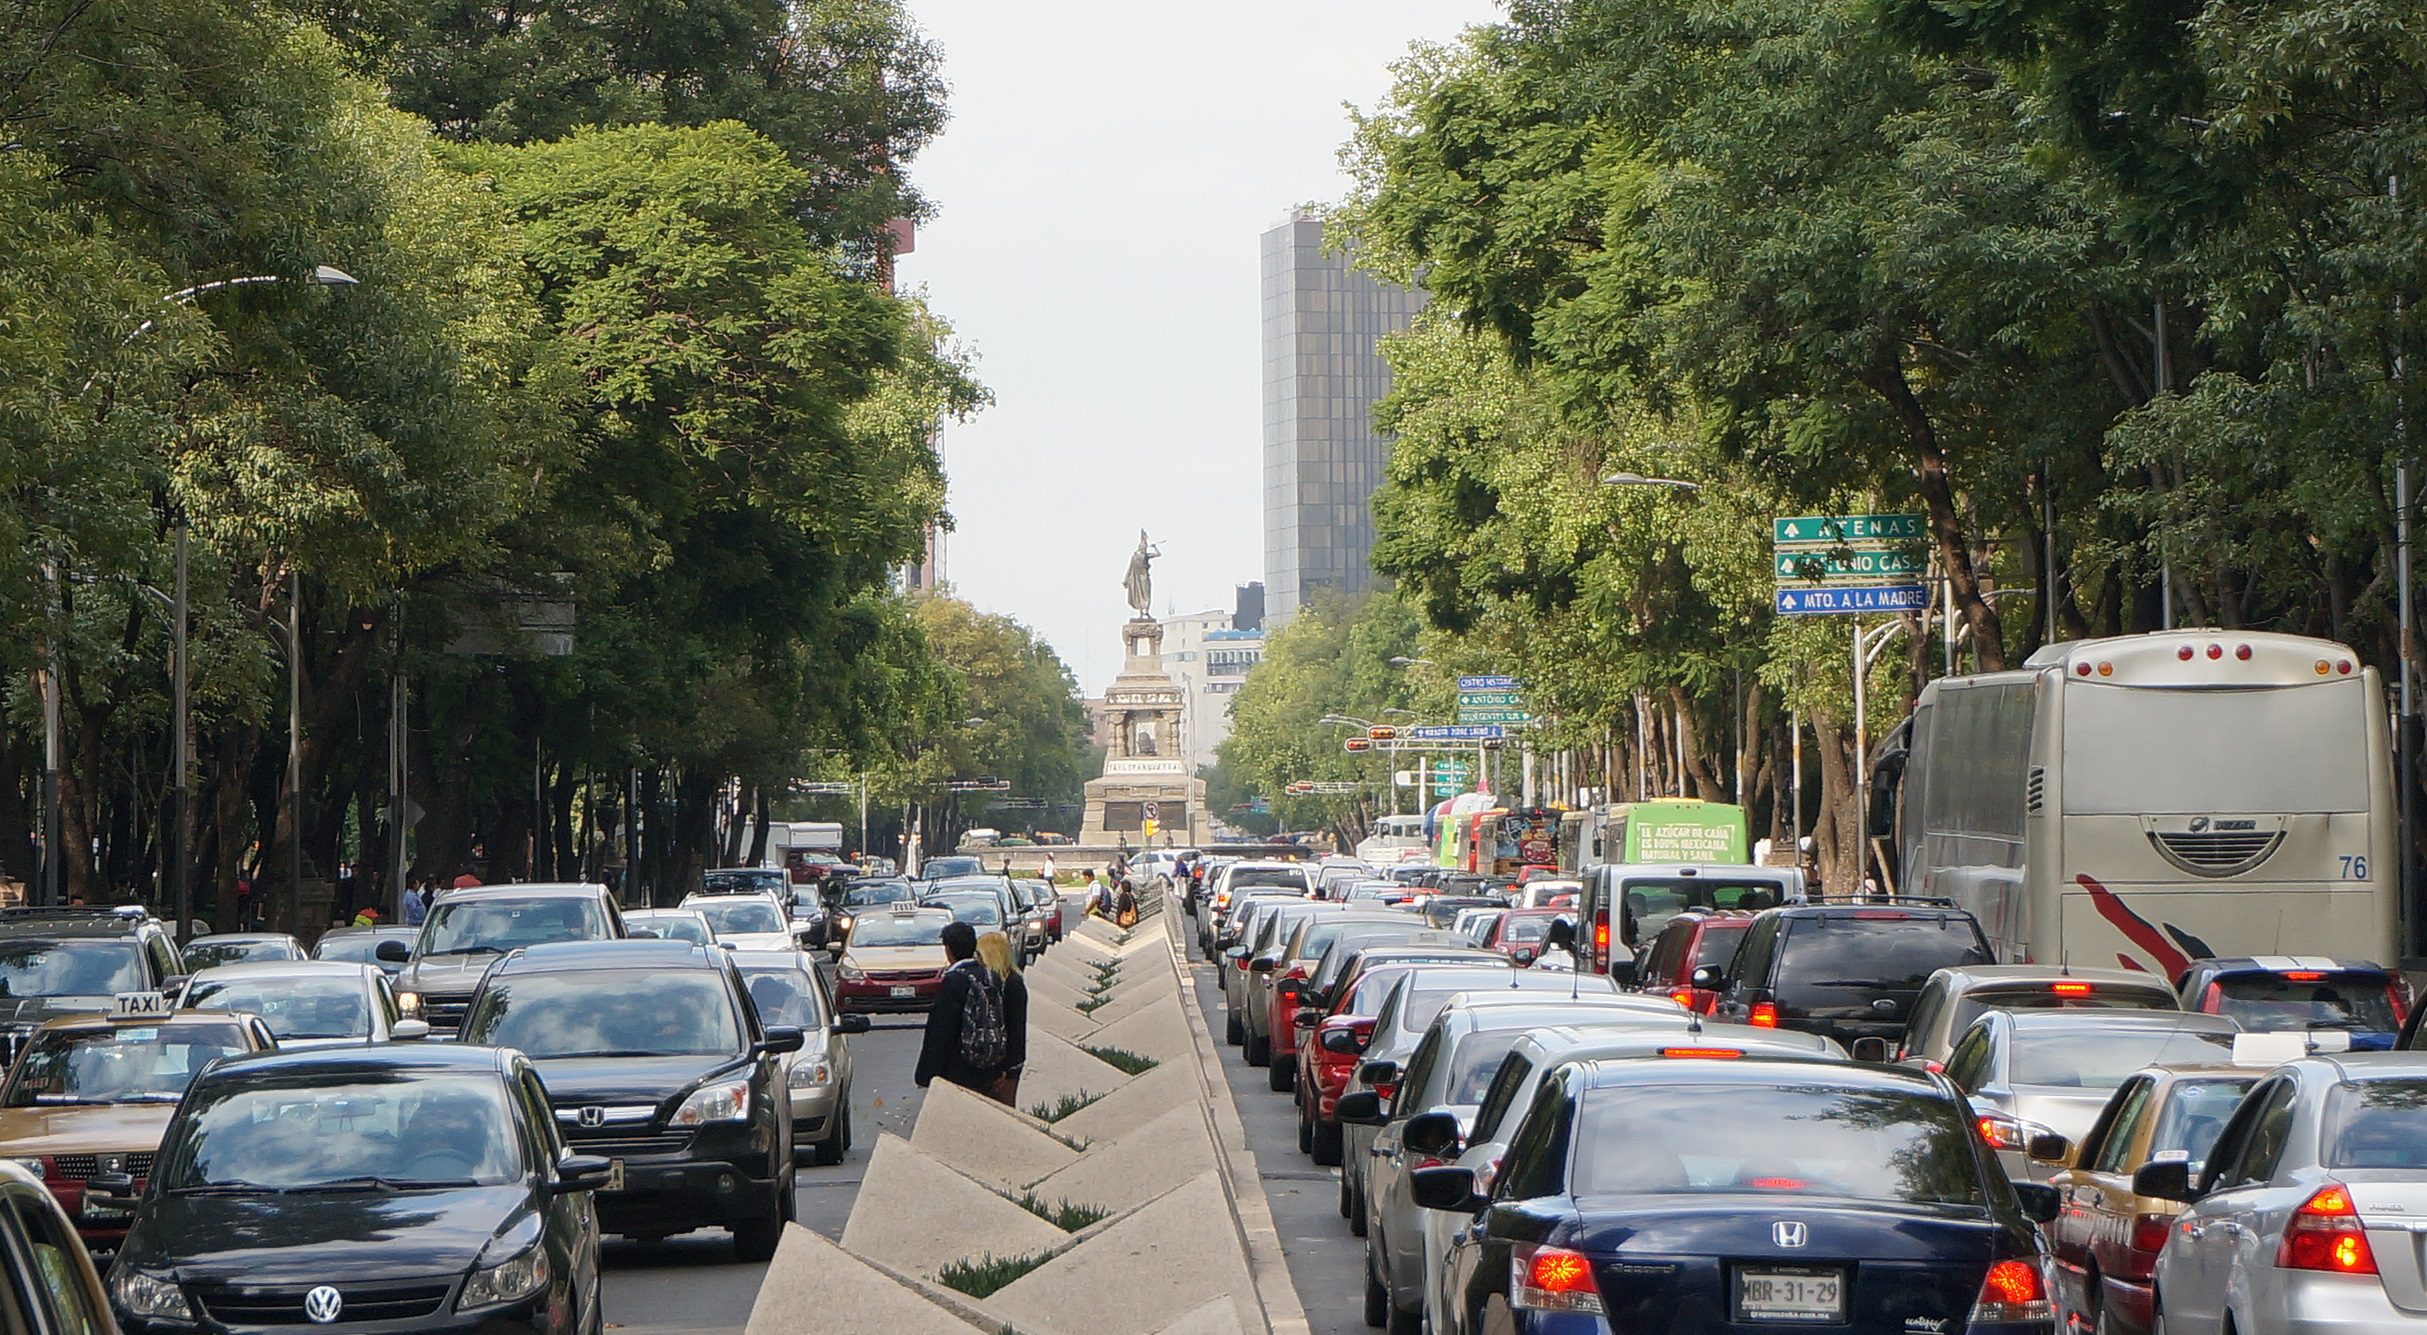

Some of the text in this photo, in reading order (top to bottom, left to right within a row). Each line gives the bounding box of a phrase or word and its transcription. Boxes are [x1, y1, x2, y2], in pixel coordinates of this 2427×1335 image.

[1804, 593, 1837, 608] MTO.
[1856, 592, 1873, 607] LA
[1879, 590, 1923, 606] MADRE
[1692, 828, 1702, 838] DE
[1641, 839, 1652, 848] ES
[1641, 850, 1681, 860] NATURAL
[1681, 850, 1689, 860] Y
[2338, 856, 2367, 879] 76
[118, 996, 160, 1013] TAXI
[1743, 1279, 1837, 1304] MBR-31-29
